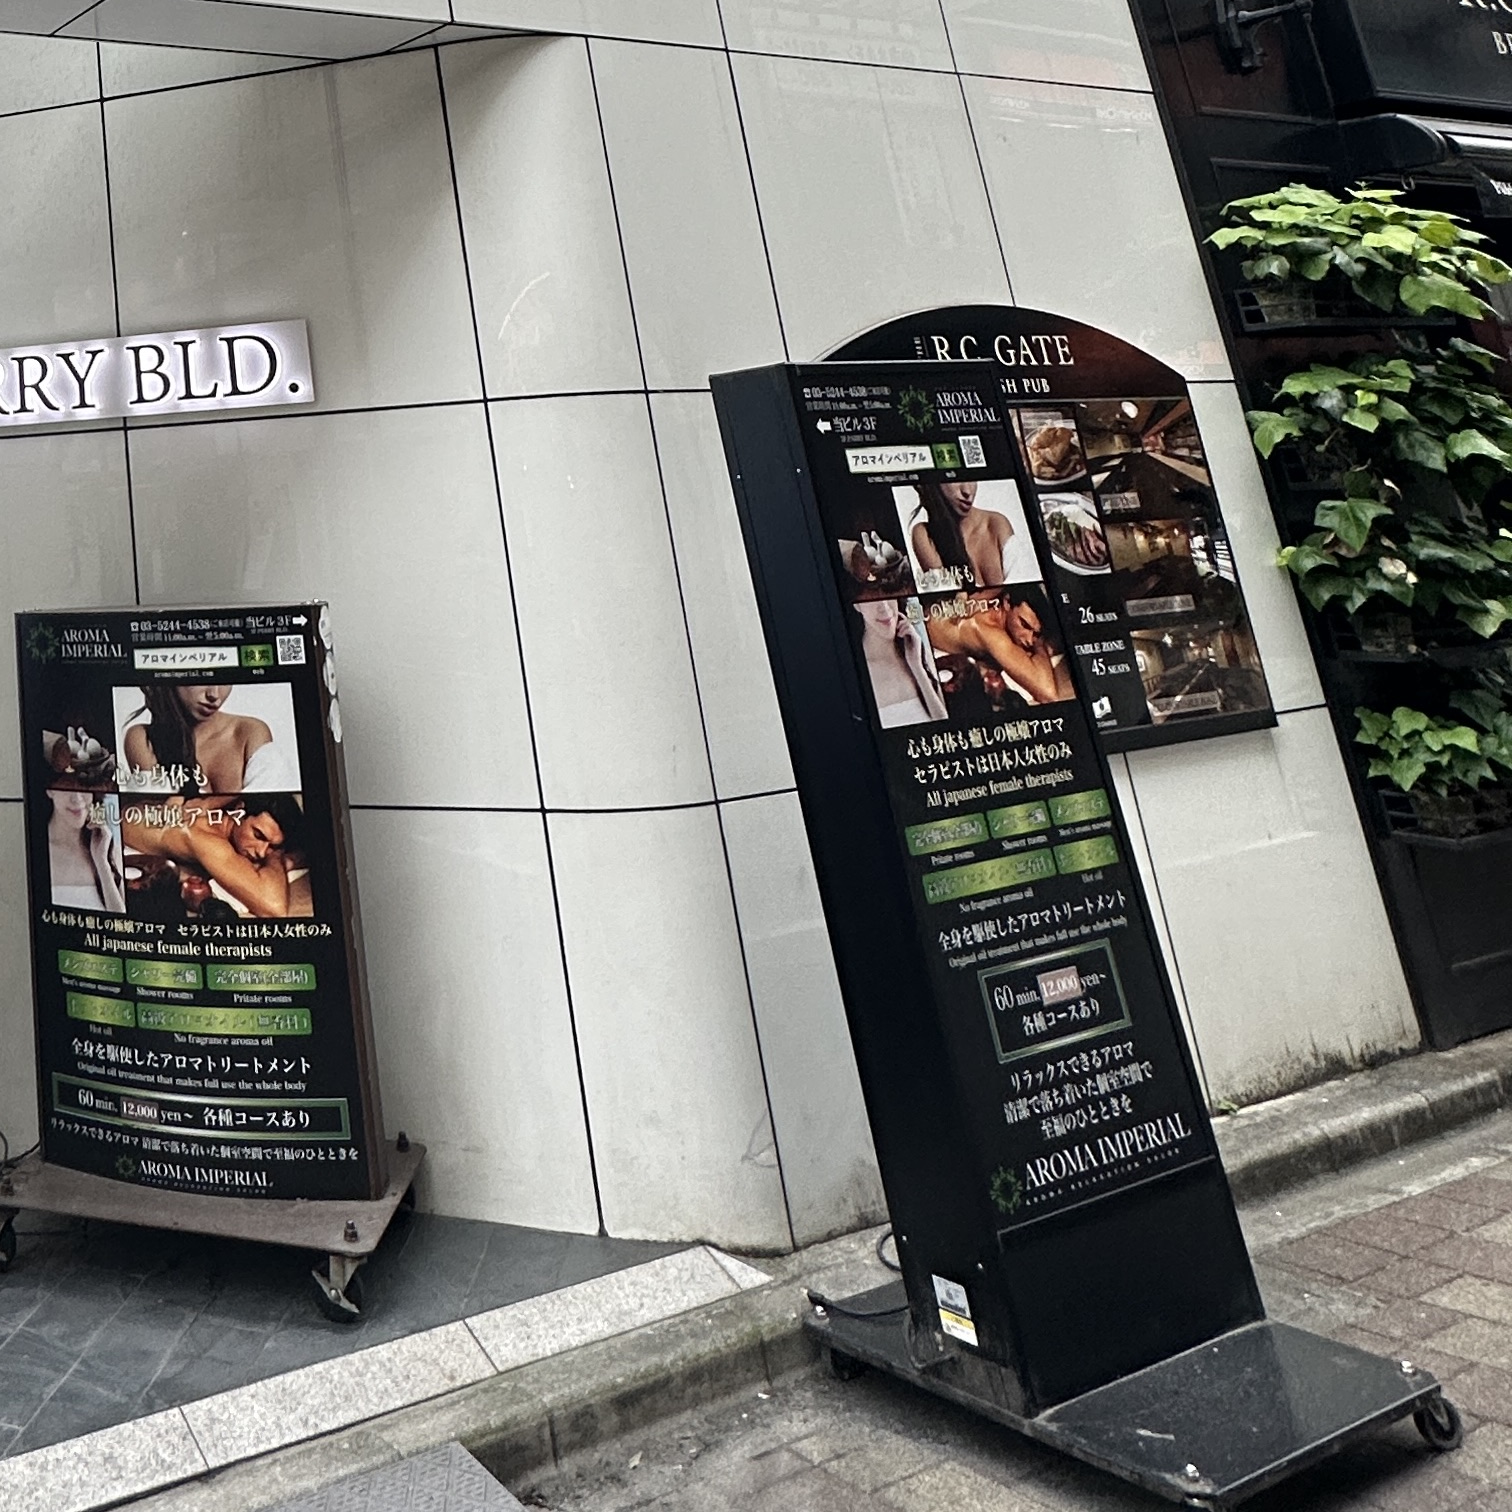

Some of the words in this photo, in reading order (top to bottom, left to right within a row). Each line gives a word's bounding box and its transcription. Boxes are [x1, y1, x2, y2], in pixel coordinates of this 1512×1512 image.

[994, 334, 1075, 366] GATE
[125, 334, 301, 405] BLD.
[935, 391, 983, 407] AROMA
[1022, 377, 1050, 394] PUB
[938, 407, 1001, 424] IMPERIAL
[1078, 606, 1095, 624] 26
[62, 628, 110, 643] AROMA
[60, 642, 128, 658] IMPERIAL
[1091, 658, 1106, 676] 45
[111, 763, 208, 787] 心も身体も
[914, 741, 1073, 785] セラピストは日本人女性のみ
[926, 791, 940, 808] All
[942, 785, 988, 808] japanese
[989, 775, 1024, 795] female
[1025, 768, 1074, 789] therapists
[177, 923, 333, 938] セラピストは日本人女性のみ
[84, 933, 100, 948] All
[101, 935, 154, 953] japanese
[157, 940, 201, 956] female
[205, 942, 273, 960] therapists
[994, 984, 1015, 1011] 60
[1015, 986, 1041, 1006] min.
[1040, 974, 1078, 998] 12,000
[1022, 997, 1100, 1037] 各種コースあり
[1010, 1041, 1134, 1092] リラックスできるアロマ
[78, 1088, 94, 1107] 60
[95, 1096, 118, 1112] min.
[121, 1101, 158, 1119] 12,000
[202, 1107, 310, 1129] 各種コースあり
[1025, 1142, 1099, 1191] AROMA
[1096, 1112, 1192, 1165] IMPERIAL
[138, 1159, 192, 1182] AROMA
[193, 1166, 274, 1188] IMPERIAL
